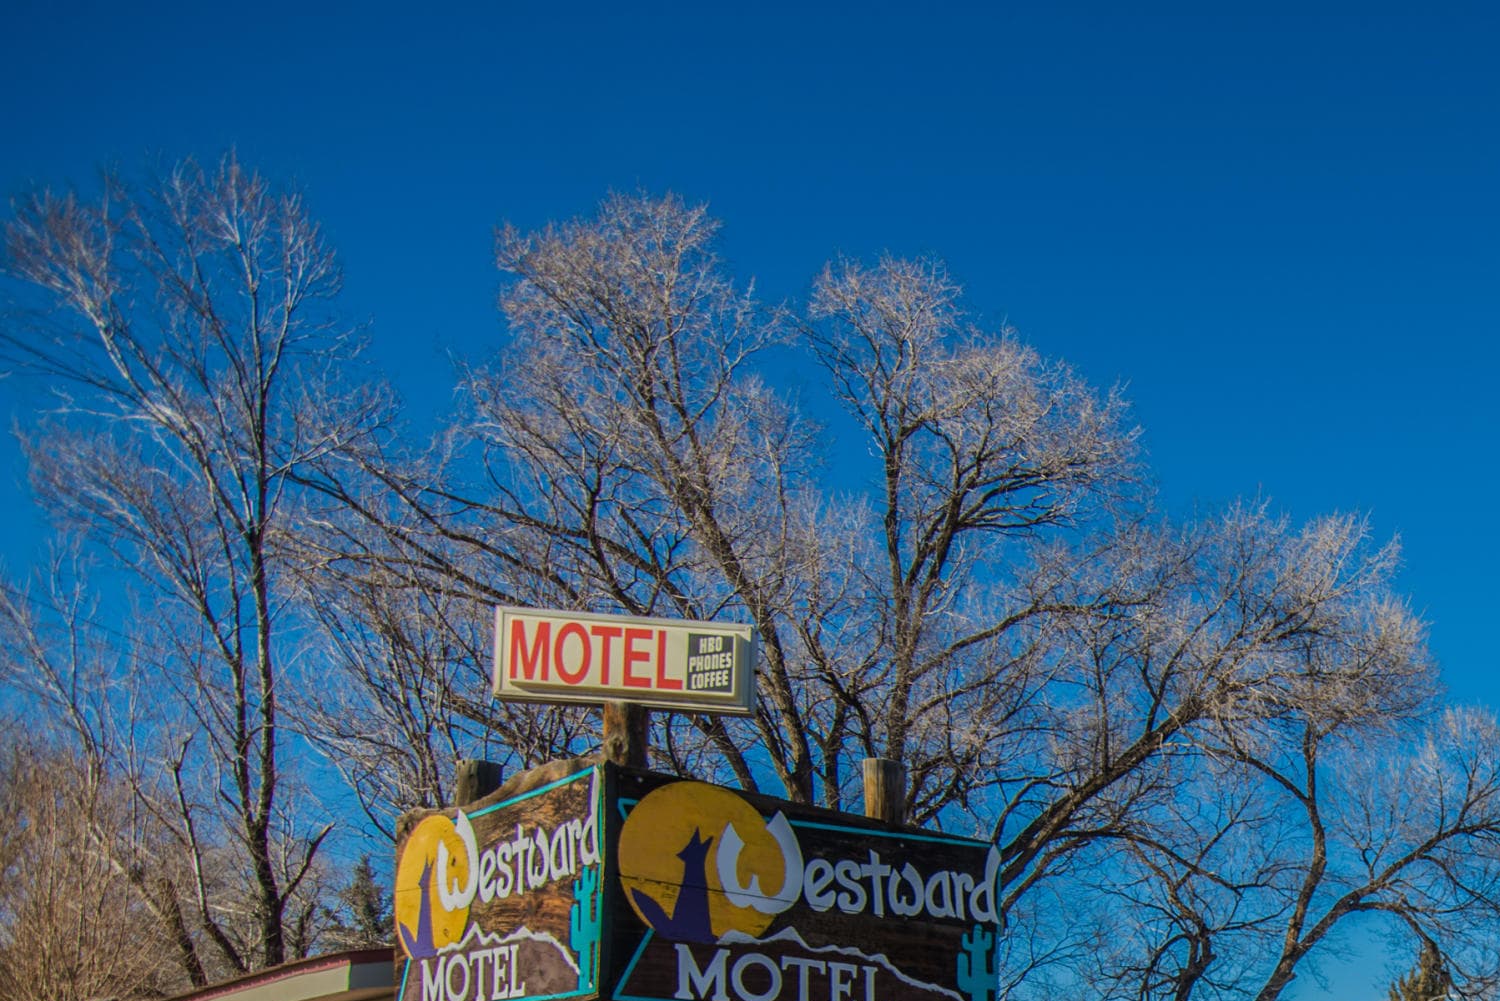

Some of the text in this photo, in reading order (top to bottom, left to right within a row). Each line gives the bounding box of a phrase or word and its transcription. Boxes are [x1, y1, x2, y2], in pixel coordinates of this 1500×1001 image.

[510, 619, 683, 690] MOTEL
[689, 652, 732, 672] PHONES
[699, 636, 722, 654] HBO
[691, 670, 729, 689] COFFEE
[436, 764, 601, 912] Westward
[716, 810, 1001, 925] Westward
